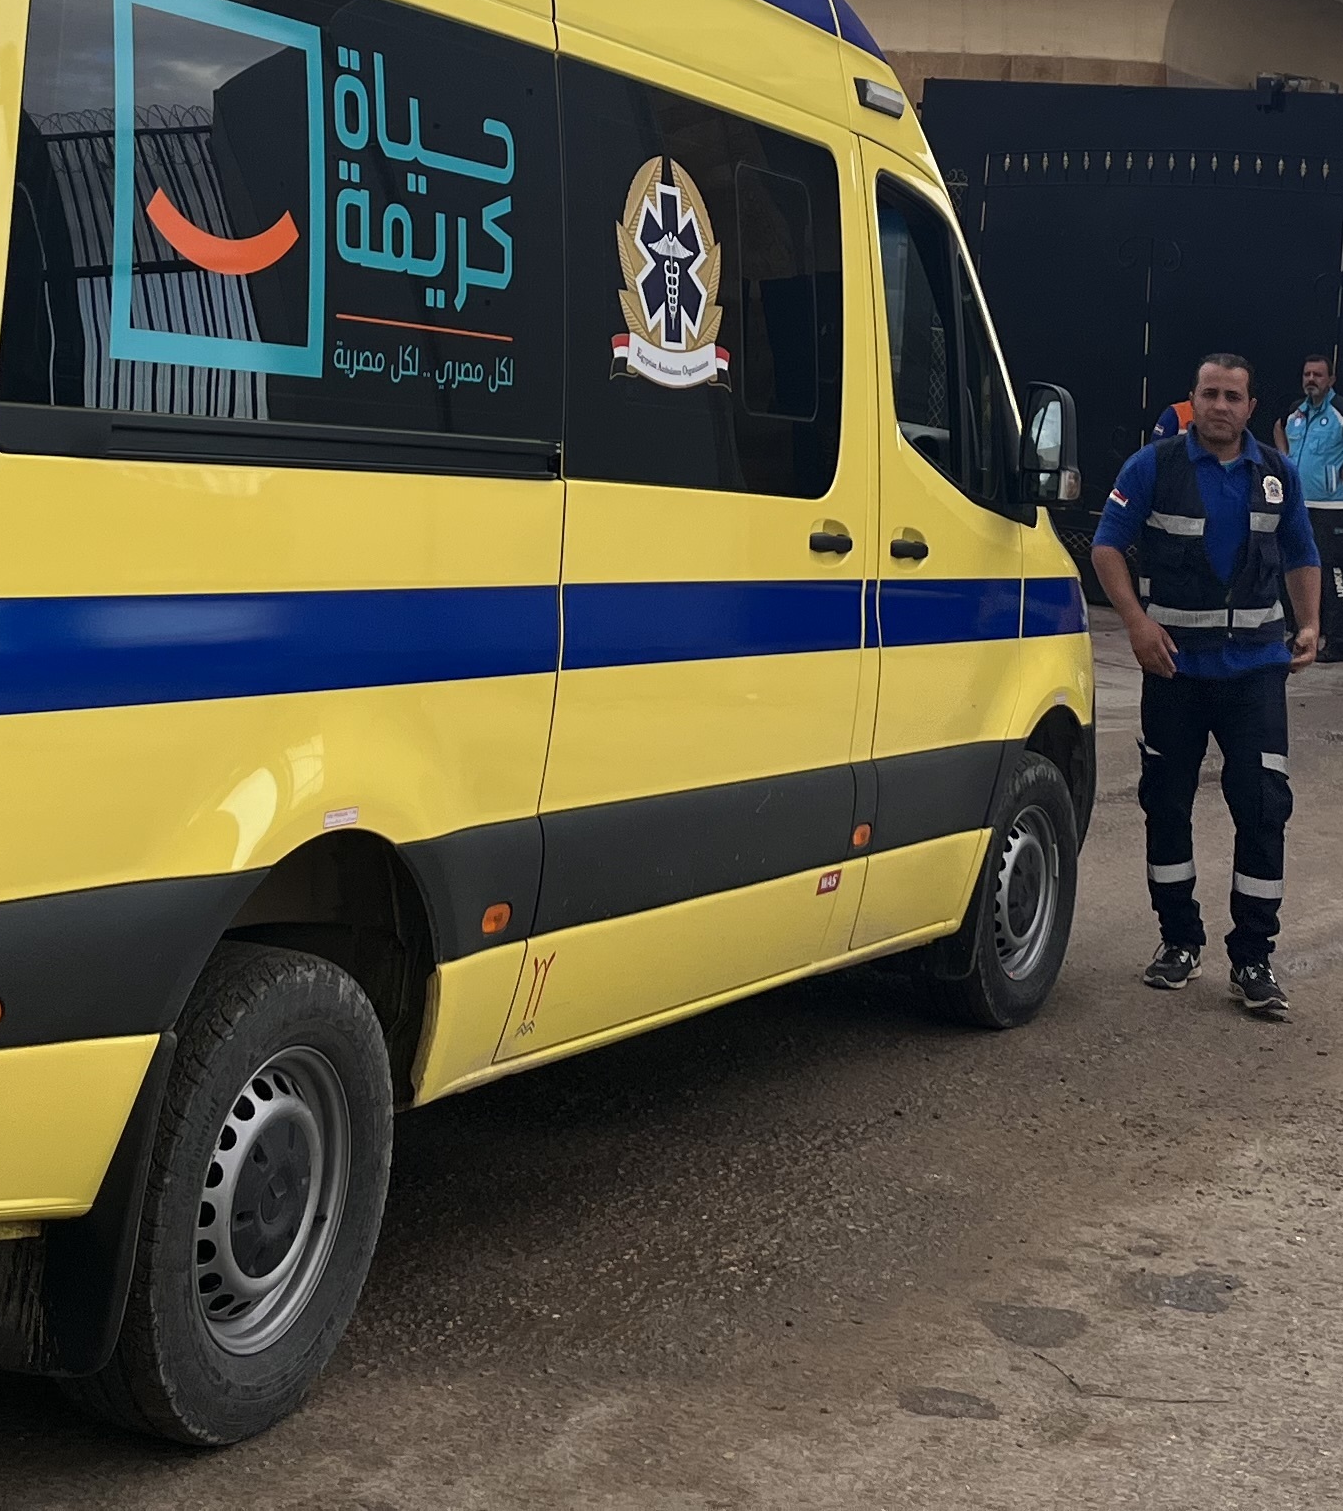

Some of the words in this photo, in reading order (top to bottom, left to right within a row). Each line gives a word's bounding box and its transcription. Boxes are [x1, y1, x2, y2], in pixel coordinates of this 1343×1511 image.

[333, 45, 516, 195] حياة
[335, 159, 514, 312] كريمة
[333, 340, 386, 379] مصرية
[390, 344, 420, 383] لكل
[435, 360, 485, 390] مصري
[488, 356, 514, 393] لكل
